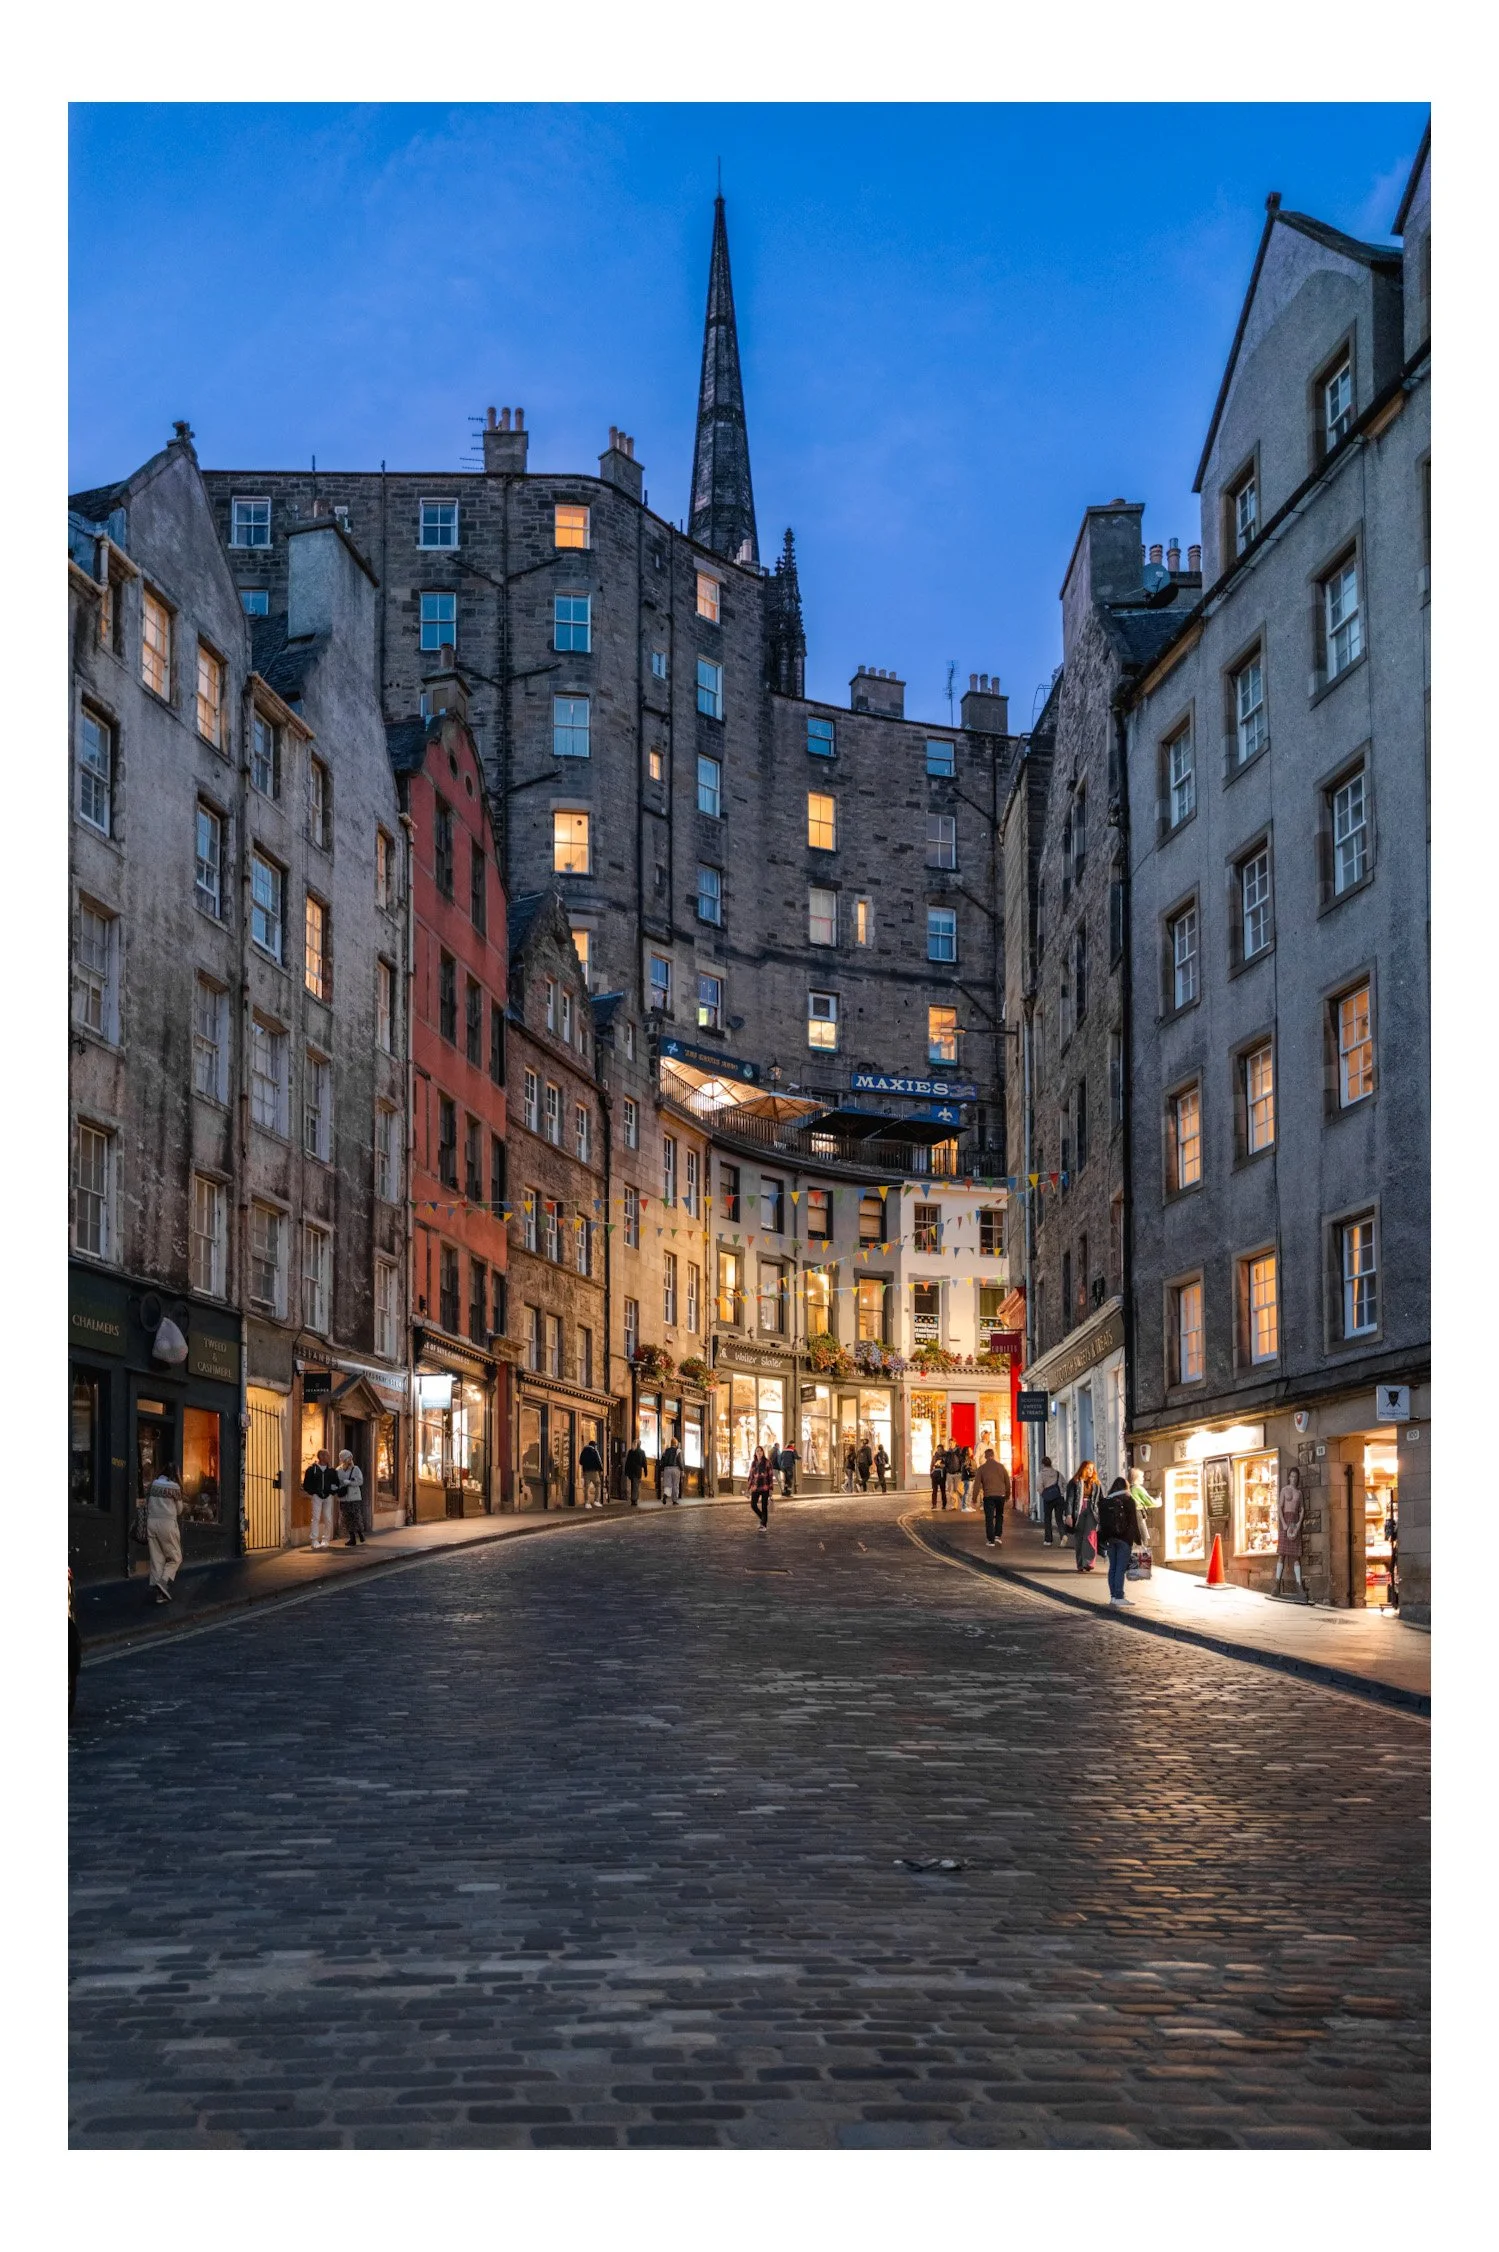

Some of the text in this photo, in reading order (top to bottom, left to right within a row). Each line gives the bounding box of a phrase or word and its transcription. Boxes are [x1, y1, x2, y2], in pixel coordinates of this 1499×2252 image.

[855, 1075, 949, 1096] MAXIES
[72, 1314, 120, 1337] CHALMERS
[203, 1337, 227, 1353] TWEED
[1095, 1328, 1114, 1354] TREATS
[197, 1361, 231, 1378] CASHMERE
[760, 1355, 783, 1368] Slater
